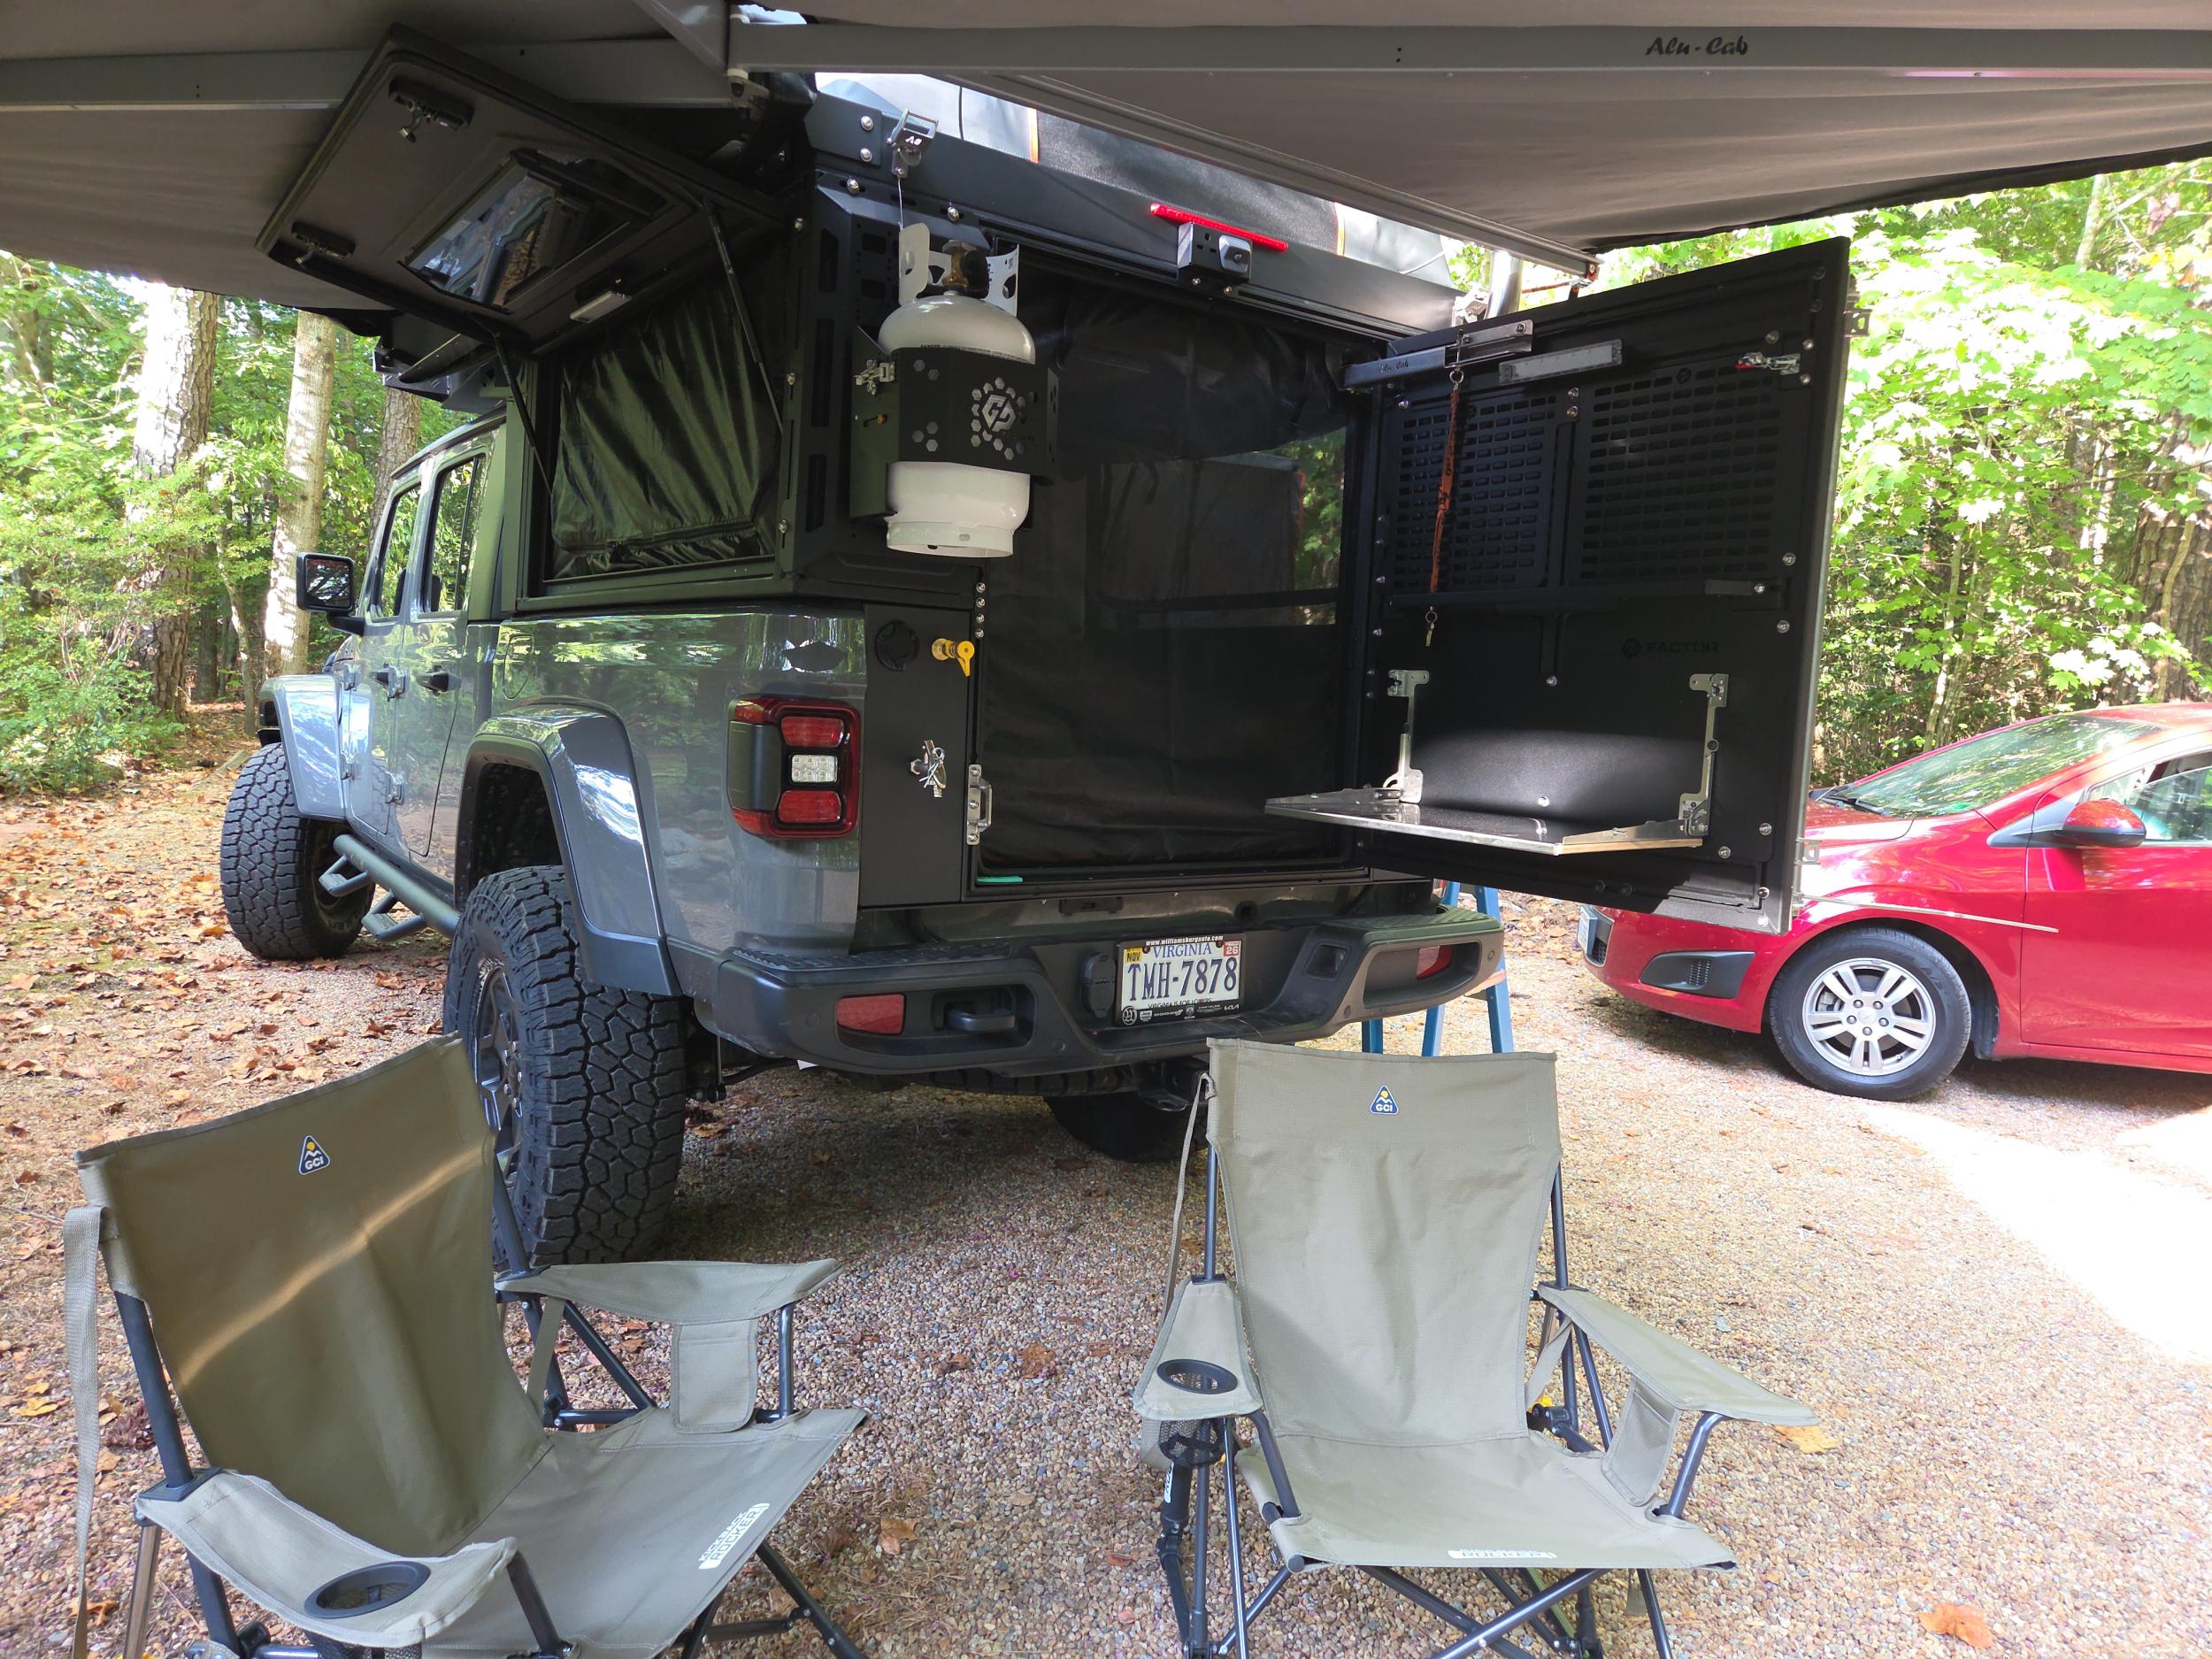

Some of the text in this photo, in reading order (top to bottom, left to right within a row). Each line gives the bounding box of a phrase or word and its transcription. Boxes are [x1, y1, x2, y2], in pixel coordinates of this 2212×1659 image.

[1126, 951, 1141, 962] NOV
[1154, 942, 1212, 958] VIRGINIA
[1225, 946, 1239, 955] 26
[1128, 956, 1238, 1002] TMH-7878
[1375, 1103, 1394, 1112] GCI
[304, 1156, 324, 1170] GCI
[709, 1510, 757, 1561] ROCKER
